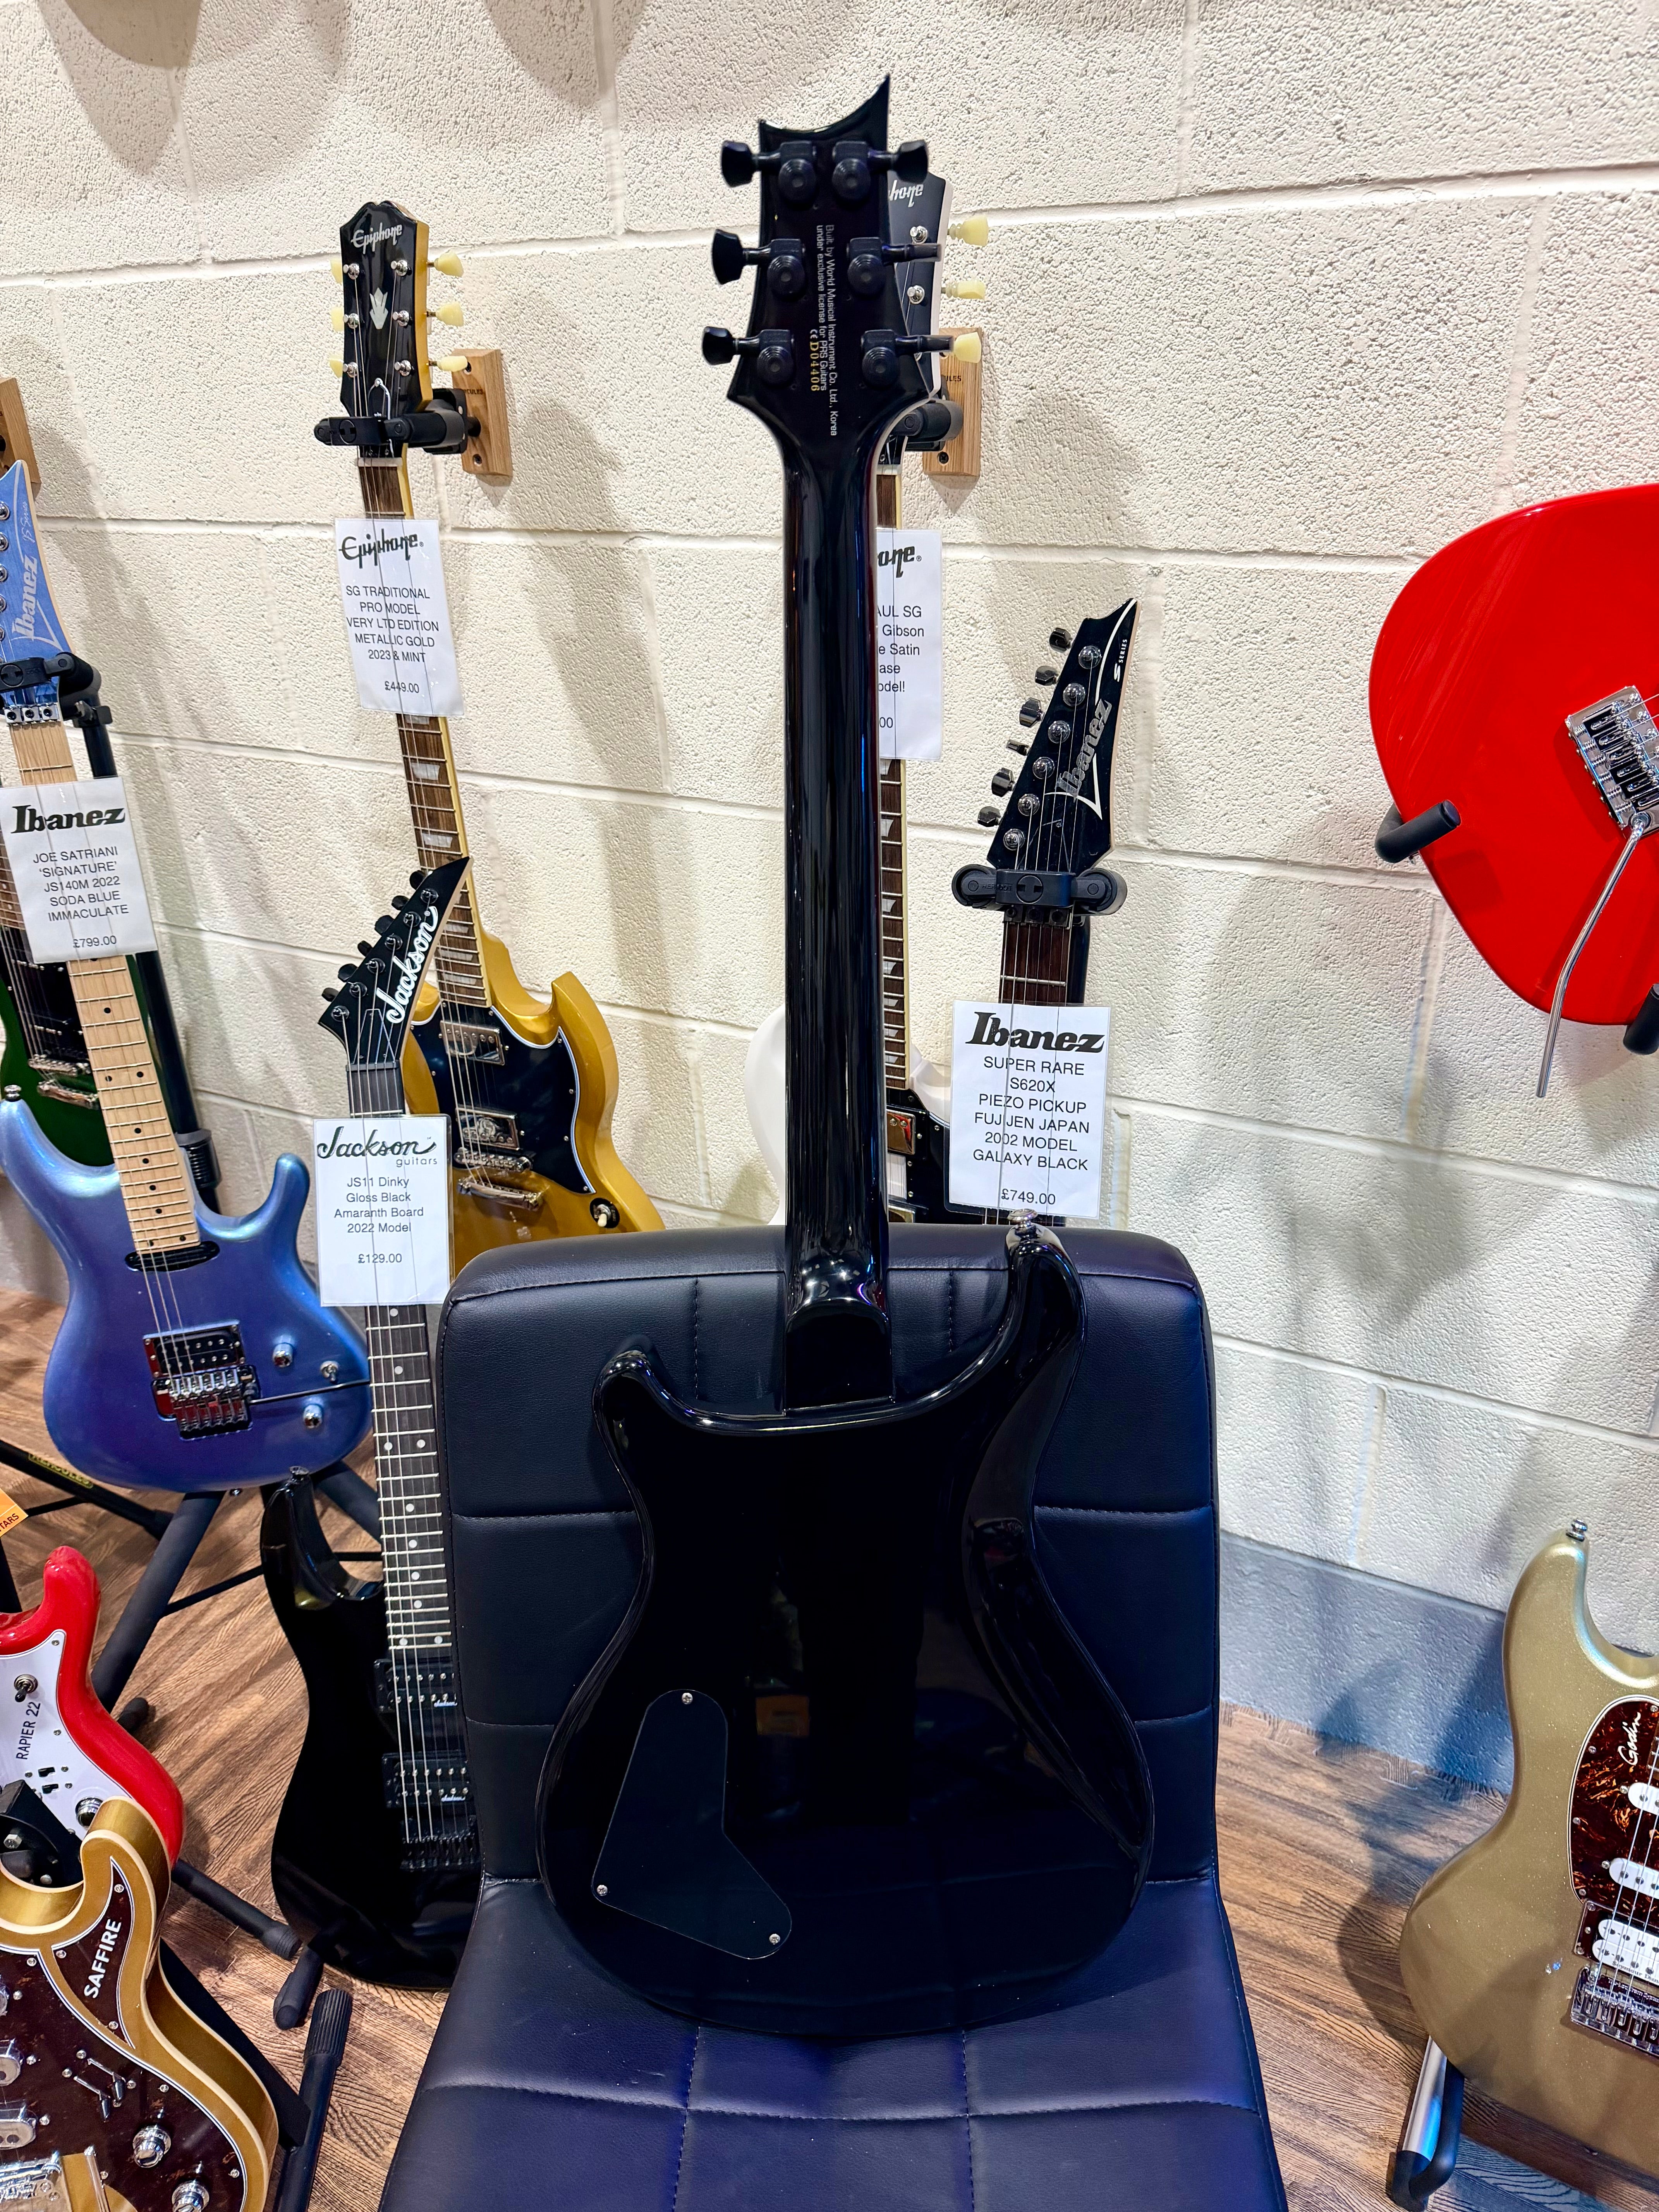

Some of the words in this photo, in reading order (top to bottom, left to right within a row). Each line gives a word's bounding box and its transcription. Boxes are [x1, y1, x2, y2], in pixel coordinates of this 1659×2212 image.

[889, 180, 924, 208] hone
[350, 222, 403, 254] Epiphone
[816, 225, 825, 251] under
[826, 225, 835, 245] Built
[824, 247, 834, 257] by
[817, 254, 826, 291] exclusive
[826, 259, 836, 286] World
[818, 294, 826, 323] license
[827, 289, 836, 321] Musical
[819, 326, 828, 338] for
[819, 340, 828, 358] PRS
[828, 324, 837, 370] Instrument
[820, 361, 829, 391] Guitars
[830, 411, 839, 436] Korea
[338, 528, 418, 569] Epiphone
[12, 555, 37, 641] Ibanez
[346, 586, 361, 596] SG
[363, 586, 430, 599] TRADITIONAL
[360, 602, 382, 612] PRO
[385, 603, 421, 615] MODEL
[903, 605, 922, 618] SG
[347, 617, 373, 628] VERY
[377, 618, 395, 629] LTD
[398, 620, 439, 632] EDITION
[882, 624, 924, 637] Gibson
[355, 633, 403, 645] METALLIC
[406, 635, 435, 647] GOLD
[368, 650, 391, 660] 2023
[393, 651, 400, 661] &
[402, 652, 426, 663] MINT
[890, 643, 920, 656] Satin
[879, 664, 901, 674] ase
[1114, 663, 1121, 682] S
[1118, 639, 1127, 663] SERIES
[385, 681, 420, 693] £449.00
[878, 681, 905, 692] odel!
[1055, 699, 1112, 803] Ibanez
[10, 805, 126, 834] Ibanez
[33, 852, 57, 864] JOE
[60, 846, 118, 861] SATRIANI
[44, 879, 89, 892] JS140M
[93, 876, 121, 888] 2022
[50, 895, 86, 906] SODA
[88, 891, 121, 902] BLUE
[48, 904, 129, 922] IMMACULATE
[73, 935, 117, 948] £799.00
[376, 906, 438, 1024] Jackson
[965, 1012, 1105, 1053] Ibanez
[984, 1056, 1036, 1072] SUPER
[1041, 1061, 1084, 1075] RARE
[1010, 1077, 1056, 1092] S620X
[979, 1094, 1024, 1109] PIEZO
[1029, 1098, 1087, 1114] PICKUP
[975, 1112, 1034, 1129] FUJJEN
[1039, 1118, 1089, 1133] JAPAN
[317, 1126, 437, 1159] Jackson
[985, 1132, 1018, 1146] 2002
[1023, 1135, 1077, 1152] MODEL
[396, 1158, 438, 1168] guitars
[973, 1149, 1033, 1165] GALAXY
[1037, 1156, 1089, 1171] BLACK
[347, 1177, 374, 1187] JS11
[379, 1177, 409, 1188] Dinky
[346, 1193, 378, 1202] Gloss
[381, 1192, 411, 1202] Black
[1001, 1188, 1056, 1205] £749.00
[334, 1208, 387, 1218] Amaranth
[391, 1207, 424, 1217] Board
[347, 1223, 374, 1233] 2022
[378, 1223, 411, 1232] Model
[358, 1253, 402, 1264] £129.00
[0, 1513, 19, 1532] TARS
[16, 1721, 36, 1760] RAPIER
[26, 1702, 41, 1717] 22
[1617, 1712, 1641, 1765] Godin
[84, 1918, 122, 1999] SAFFIRE
[1644, 1973, 1659, 1983] Dun
